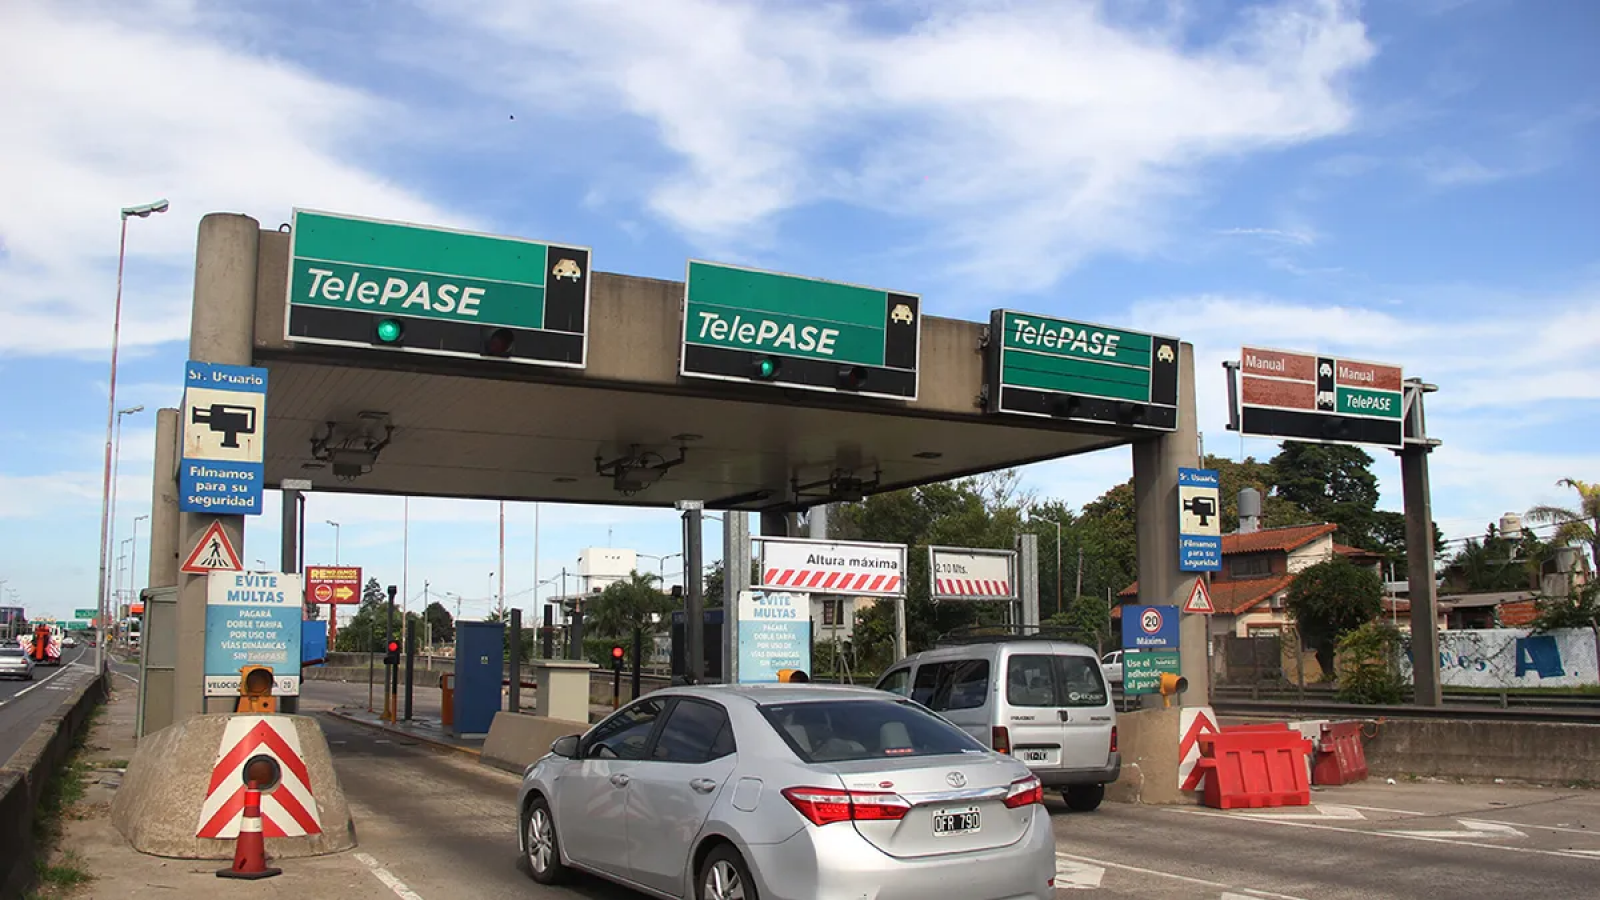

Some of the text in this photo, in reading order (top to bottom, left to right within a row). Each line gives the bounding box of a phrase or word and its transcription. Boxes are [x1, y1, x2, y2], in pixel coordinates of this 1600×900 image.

[308, 268, 486, 316] TelePASE
[699, 311, 840, 355] TelePASE
[1014, 319, 1120, 357] TelePASE
[1245, 355, 1285, 371] Manual
[1338, 366, 1374, 382] Manual
[1346, 394, 1391, 410] TelePASE
[190, 466, 254, 480] Filmamos
[195, 482, 248, 492] para su
[187, 495, 254, 507] seguridad
[1183, 540, 1217, 549] Filmamos
[1187, 550, 1204, 558] para
[806, 554, 898, 570] Altura máxima
[1184, 559, 1219, 568] seguridad
[935, 564, 951, 574] 2.10
[235, 575, 278, 588] EVITE
[227, 590, 285, 603] MULTAS
[760, 595, 791, 606] EVITE
[240, 609, 272, 617] PAGARÁ
[754, 608, 797, 619] MULTAS
[226, 620, 253, 629] DOBLE
[1144, 616, 1158, 627] 20
[229, 631, 277, 639] POR USO DE
[221, 640, 287, 649] VÍAS DINÁMICAS
[233, 652, 247, 660] SIN
[1126, 659, 1141, 667] Use
[1143, 659, 1150, 667] el
[208, 682, 241, 690] VELOCID
[1127, 680, 1136, 688] al
[934, 813, 979, 832] OFR 790
